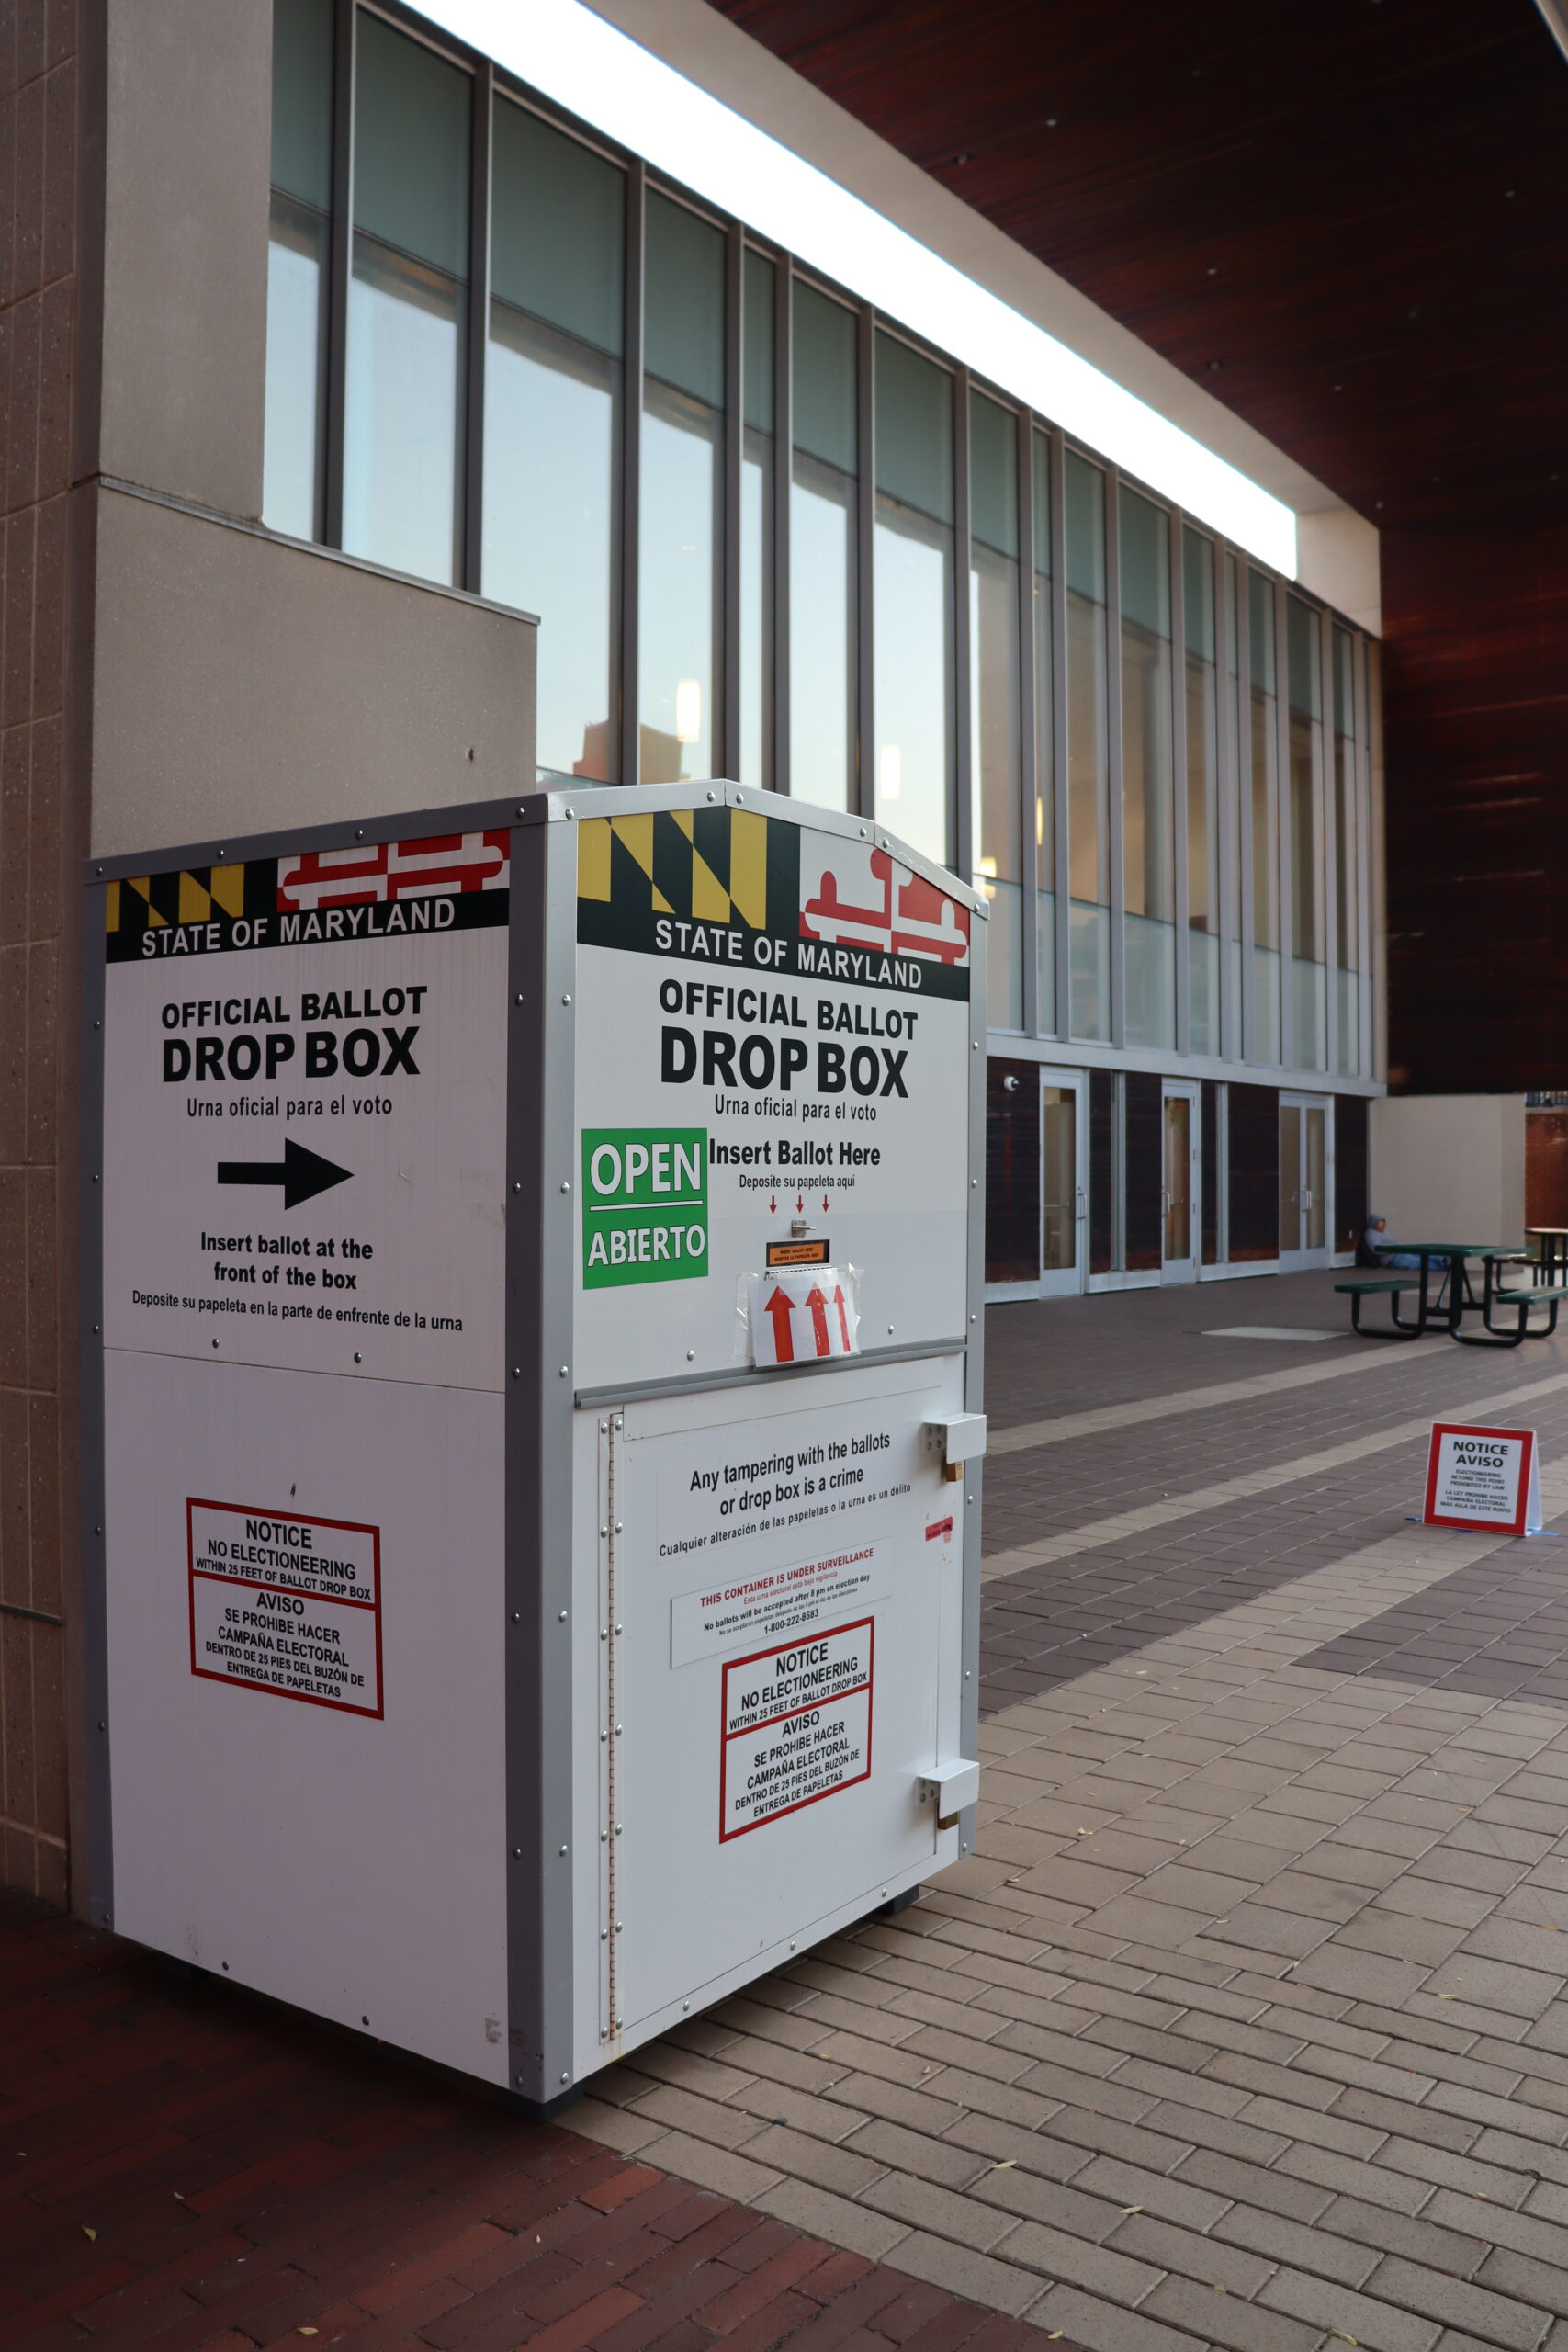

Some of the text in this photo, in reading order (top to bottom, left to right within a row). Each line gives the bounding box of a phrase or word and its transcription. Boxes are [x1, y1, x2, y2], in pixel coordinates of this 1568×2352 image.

[143, 899, 454, 956] STATE OF MARYLAND
[656, 919, 921, 988] STATE OF MARYLAND
[162, 986, 427, 1029] OFFICIAL BALLOT
[660, 979, 918, 1040] OFFICIAL BALLOT
[163, 1026, 420, 1082] DROP BOX
[662, 1026, 908, 1098] DROP BOX
[188, 1095, 392, 1120] Urna oficial para el voto
[715, 1094, 876, 1122] Urna oficial para el voto
[590, 1142, 702, 1196] OPEN
[710, 1139, 880, 1165] Insert Ballot Here
[740, 1175, 854, 1191] Deposite su papeleta aquí
[202, 1232, 373, 1259] Insert ballot at the
[588, 1225, 705, 1267] ABIERTO
[214, 1262, 356, 1289] front of the box
[133, 1290, 462, 1331] Deposite su papeleta en la parte de enfrente de la urna
[690, 1433, 889, 1492] Any tampering with the ballots
[1453, 1441, 1509, 1455] NOTICE
[1456, 1454, 1503, 1468] AVISO
[720, 1468, 863, 1515] or drop box is a crime
[246, 1519, 312, 1549] NOTICE
[660, 1537, 707, 1557] Cualquier
[711, 1523, 756, 1544] alteración
[760, 1520, 769, 1530] de
[773, 1517, 785, 1527] las
[789, 1506, 828, 1526] papeletas
[839, 1500, 845, 1510] la
[849, 1496, 865, 1507] urna
[868, 1494, 876, 1502] es
[879, 1491, 888, 1499] un
[891, 1484, 911, 1496] delito
[196, 1558, 370, 1600] WITHIN 25 FEET OF BALLOT DROP BOX
[208, 1539, 355, 1580] NO ELECTIONEERING
[700, 1548, 873, 1607] THIS CONTAINER IS UNDER SURVEILLANCE
[257, 1592, 304, 1615] AVISO
[704, 1623, 713, 1631] No
[716, 1615, 738, 1628] ballots
[740, 1609, 752, 1619] will
[764, 1597, 793, 1612] accepted
[795, 1593, 809, 1602] after
[816, 1588, 825, 1597] pm
[835, 1578, 858, 1589] election
[764, 1609, 818, 1634] 1-800-222-8683
[218, 1626, 349, 1667] CAMPAÑA ELECTORAL
[225, 1608, 340, 1644] SE PROHIBE HACER
[206, 1641, 364, 1686] DENTRO DE 25 PIES DEL BUZÓN DE
[227, 1661, 341, 1697] ENTREGA DE PAPELETAS
[777, 1642, 828, 1676] NOTICE
[730, 1672, 867, 1730] WITHIN 25 FEET OF BALLOT DROP BOX
[742, 1657, 857, 1710] NO ELECTIONEERING
[755, 1721, 844, 1767] SE PROHIBE HACER
[782, 1711, 820, 1737] AVISO
[736, 1749, 859, 1810] DENTRO DE 25 PIES DEL BUZÓN DE
[748, 1738, 849, 1789] CAMPAÑA ELECTORAL
[754, 1770, 843, 1817] ENTREGA DE PAPELETAS
